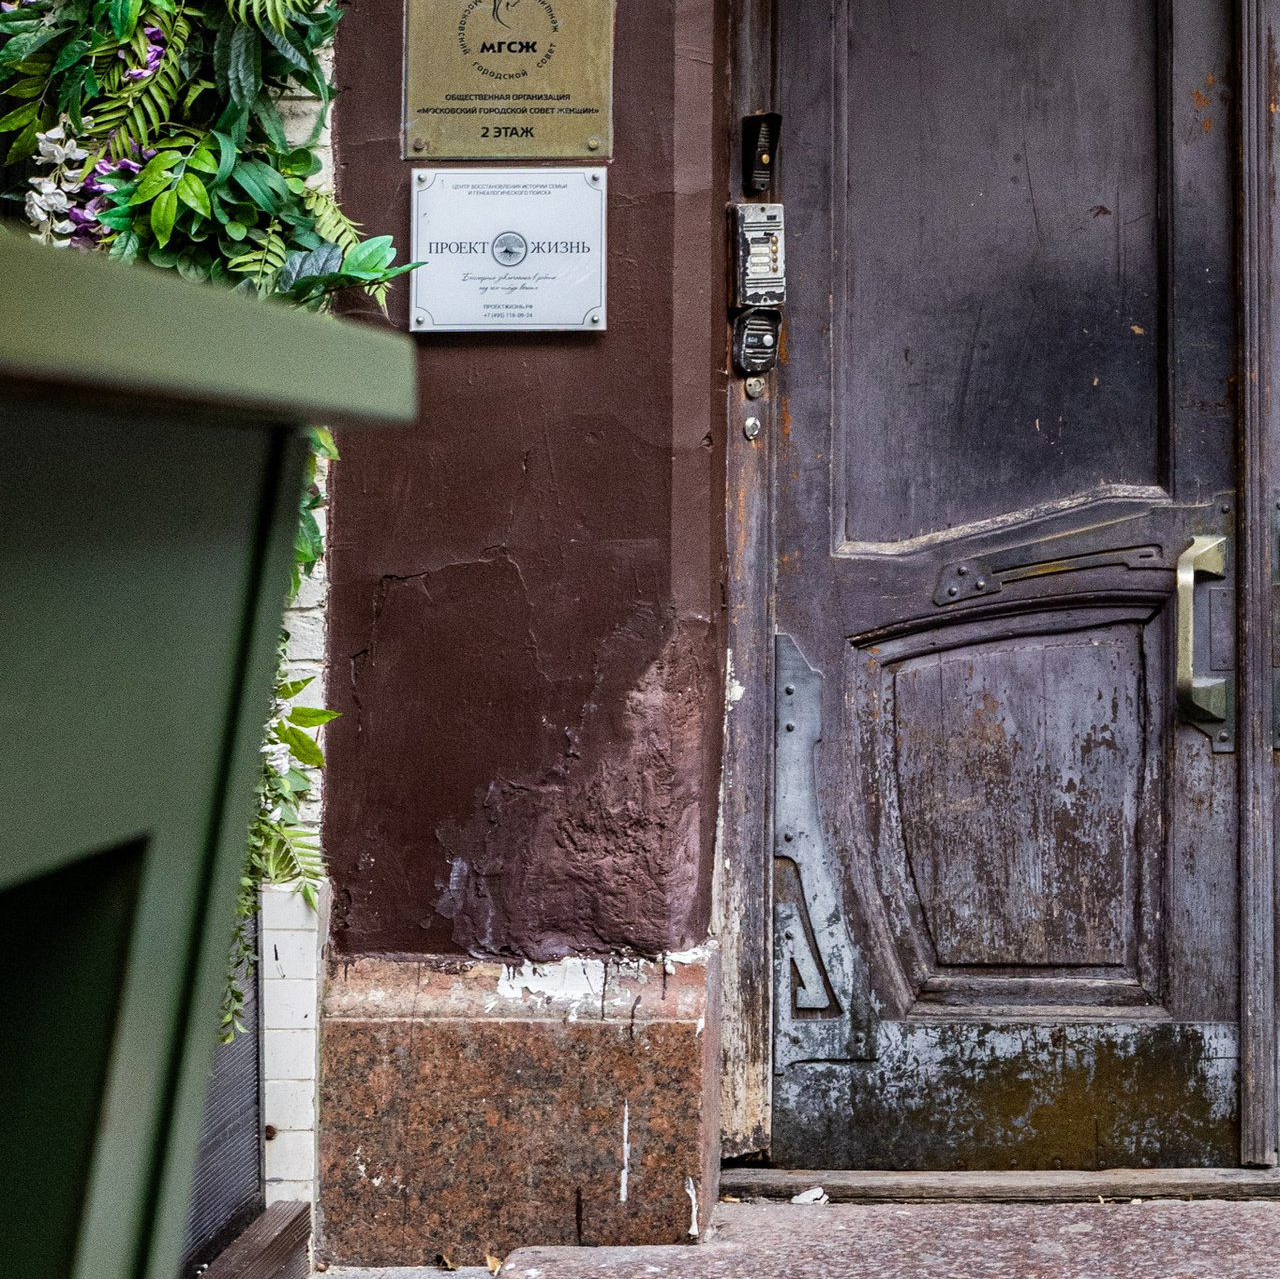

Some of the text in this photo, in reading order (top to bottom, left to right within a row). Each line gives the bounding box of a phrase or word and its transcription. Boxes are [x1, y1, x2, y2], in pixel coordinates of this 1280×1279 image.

[480, 41, 537, 53] МГСЖ
[472, 61, 528, 80] городской
[536, 42, 557, 69] совет
[445, 93, 570, 101] ОБЩЕСТВЕННАЯ ОРГАНИЗАЦИЯ
[416, 106, 477, 114] «МОСКОВСКИЙ
[479, 106, 527, 115] ГОРОДСКОЙ
[556, 107, 600, 115] ЖЕНЩИН»
[481, 126, 535, 138] 2 ЭТАЖ
[428, 241, 591, 254] ПРОЕКТ ЖИЗНЬ
